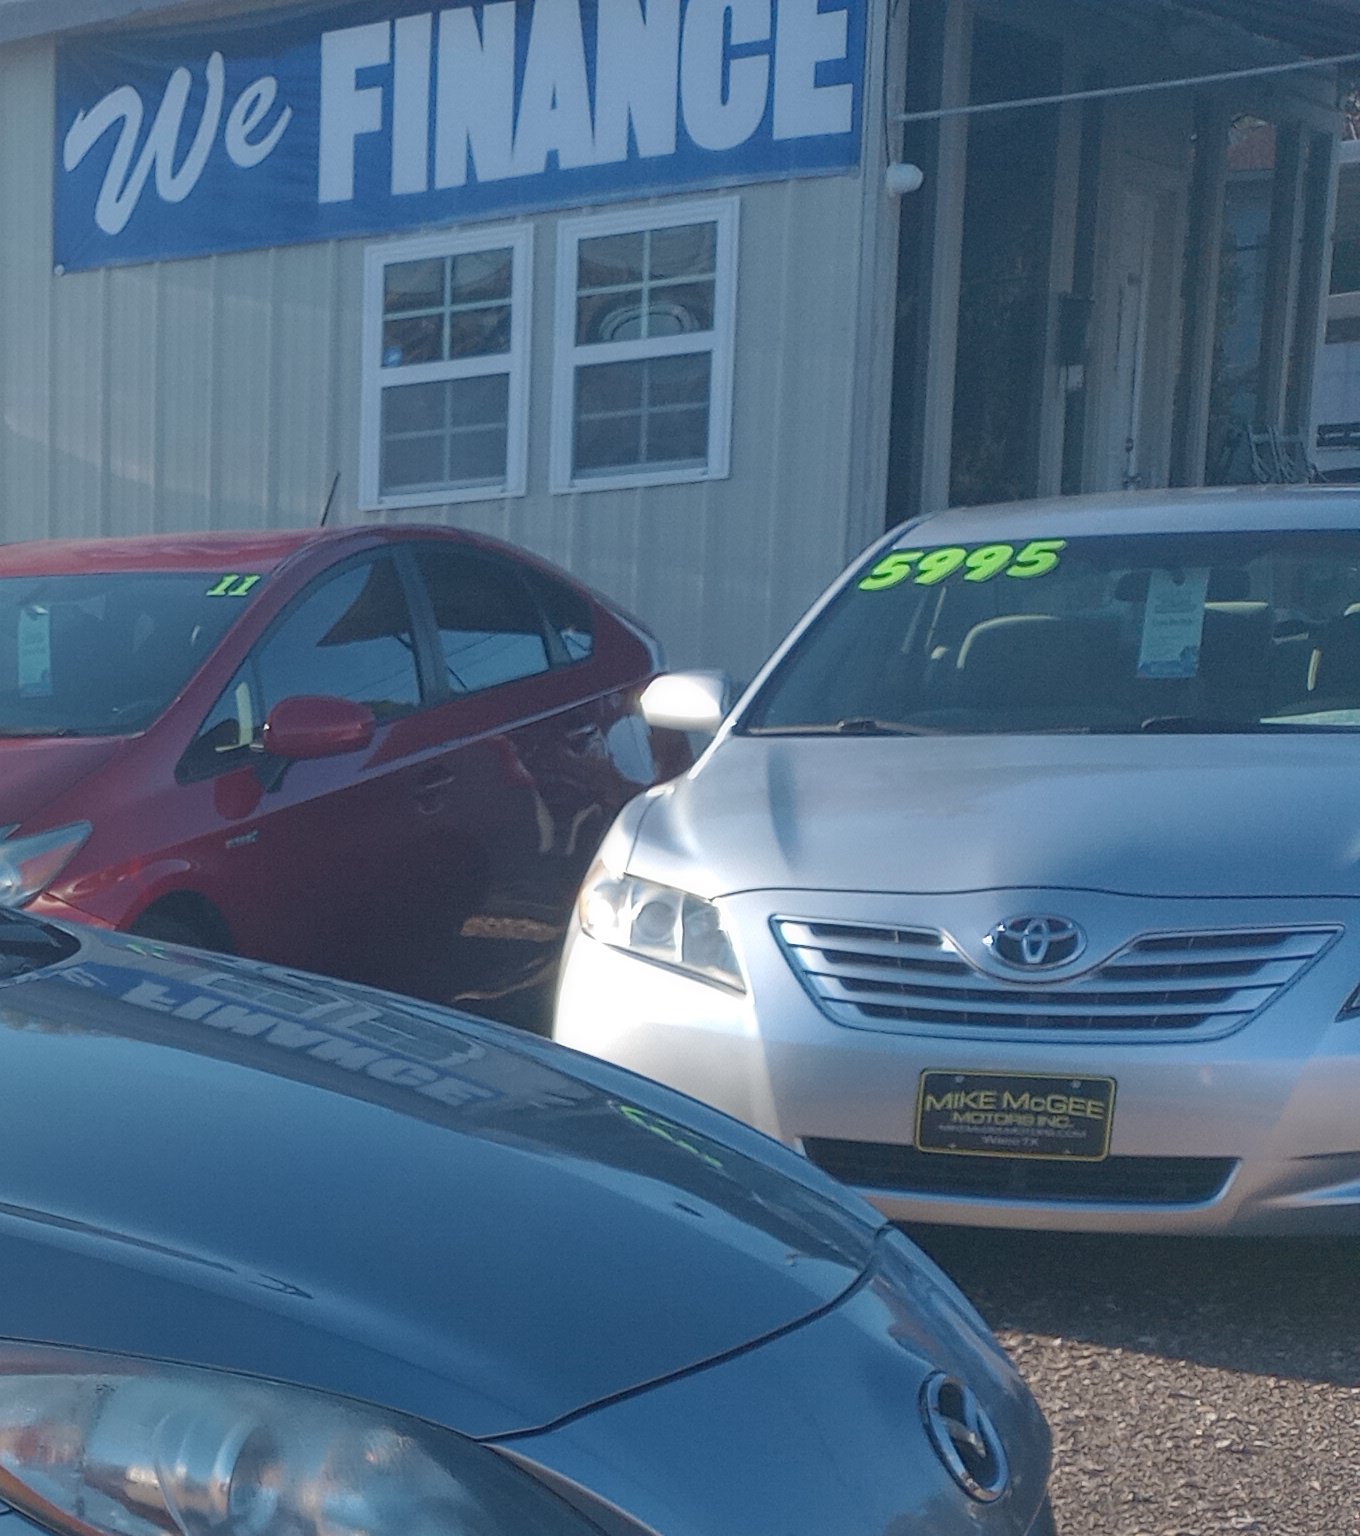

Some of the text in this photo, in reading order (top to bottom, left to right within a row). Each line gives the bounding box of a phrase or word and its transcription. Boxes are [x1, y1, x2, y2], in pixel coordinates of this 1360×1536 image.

[63, 0, 854, 235] We FINANCE
[858, 540, 1067, 591] 5995
[205, 574, 261, 597] 11
[925, 1089, 1105, 1120] MIKE McGEE
[952, 1110, 1035, 1128] MOTORS
